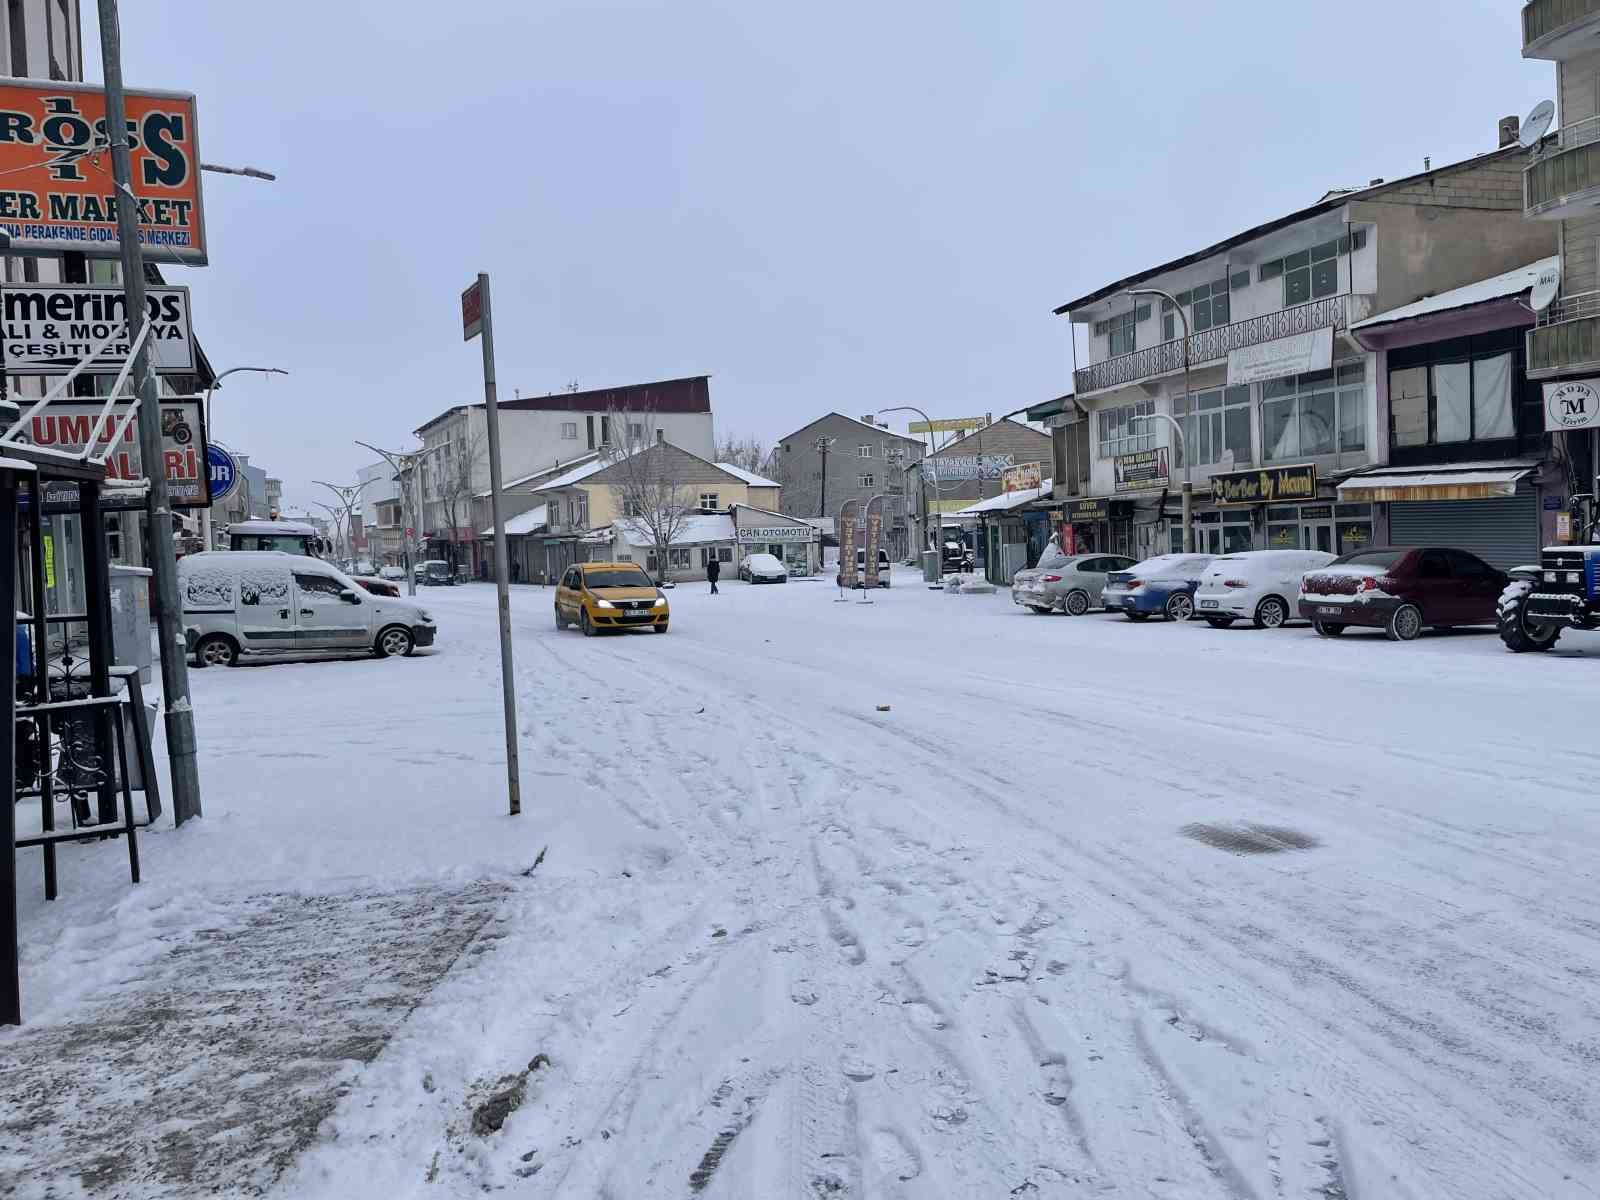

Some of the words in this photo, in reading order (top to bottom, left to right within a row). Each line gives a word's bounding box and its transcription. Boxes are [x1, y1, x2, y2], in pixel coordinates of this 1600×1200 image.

[25, 224, 86, 240] PERAKENDE
[4, 293, 180, 322] merinos
[42, 323, 61, 340] &
[31, 415, 138, 445] UMUT
